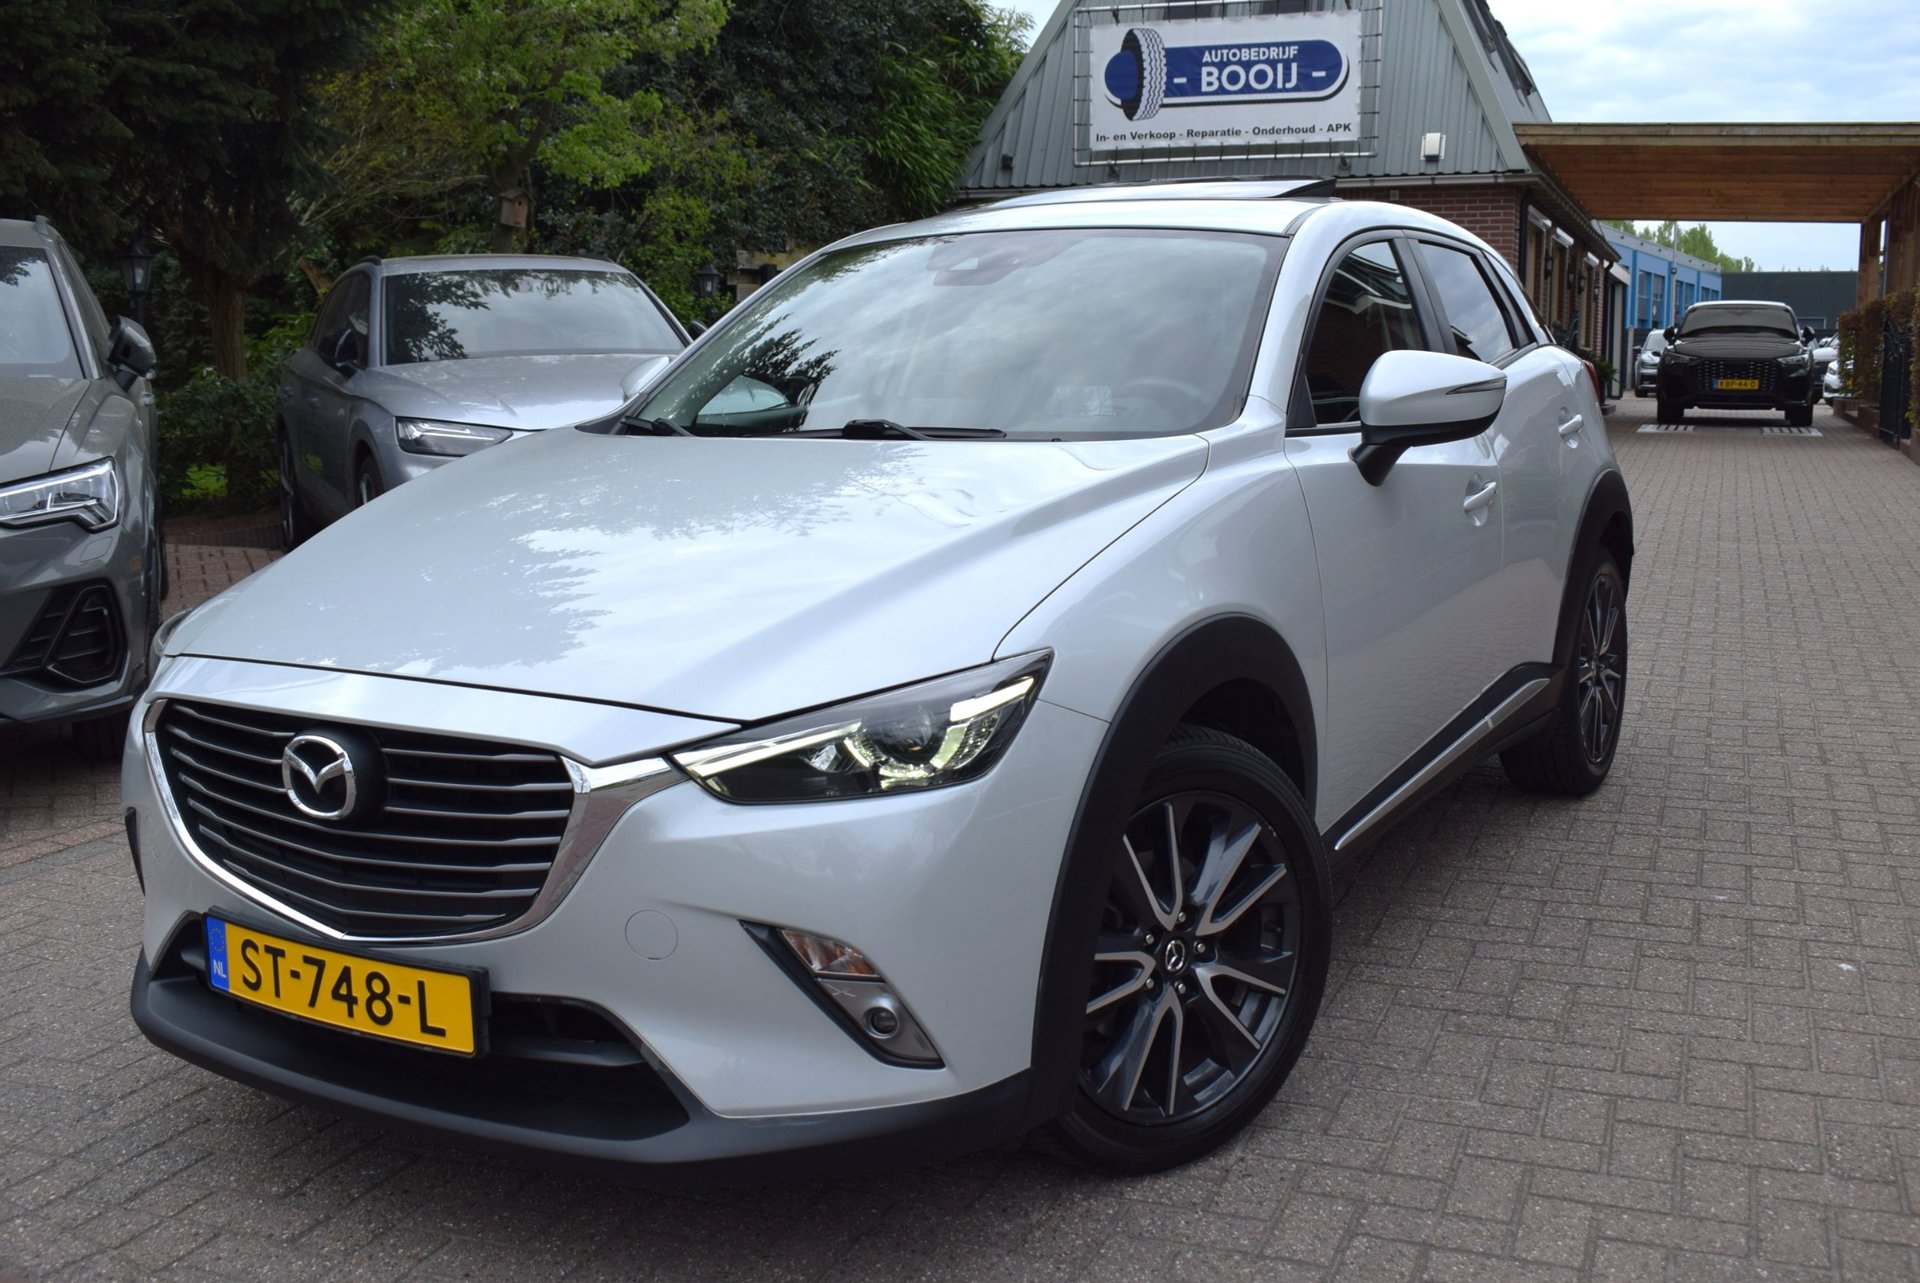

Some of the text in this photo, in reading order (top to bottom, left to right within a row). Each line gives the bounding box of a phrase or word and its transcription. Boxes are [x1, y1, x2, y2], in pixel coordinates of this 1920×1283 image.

[1202, 46, 1299, 63] AUTOBEDRIJF
[1201, 62, 1298, 92] BOOIJ
[1096, 133, 1110, 142] In-
[1113, 133, 1126, 141] en
[1130, 131, 1176, 140] Verkoop
[1186, 127, 1242, 139] Reparatie
[1252, 125, 1316, 136] Onderhoud
[1326, 123, 1352, 133] APK
[213, 959, 227, 979] NL
[240, 938, 446, 1037] ST-748-L
